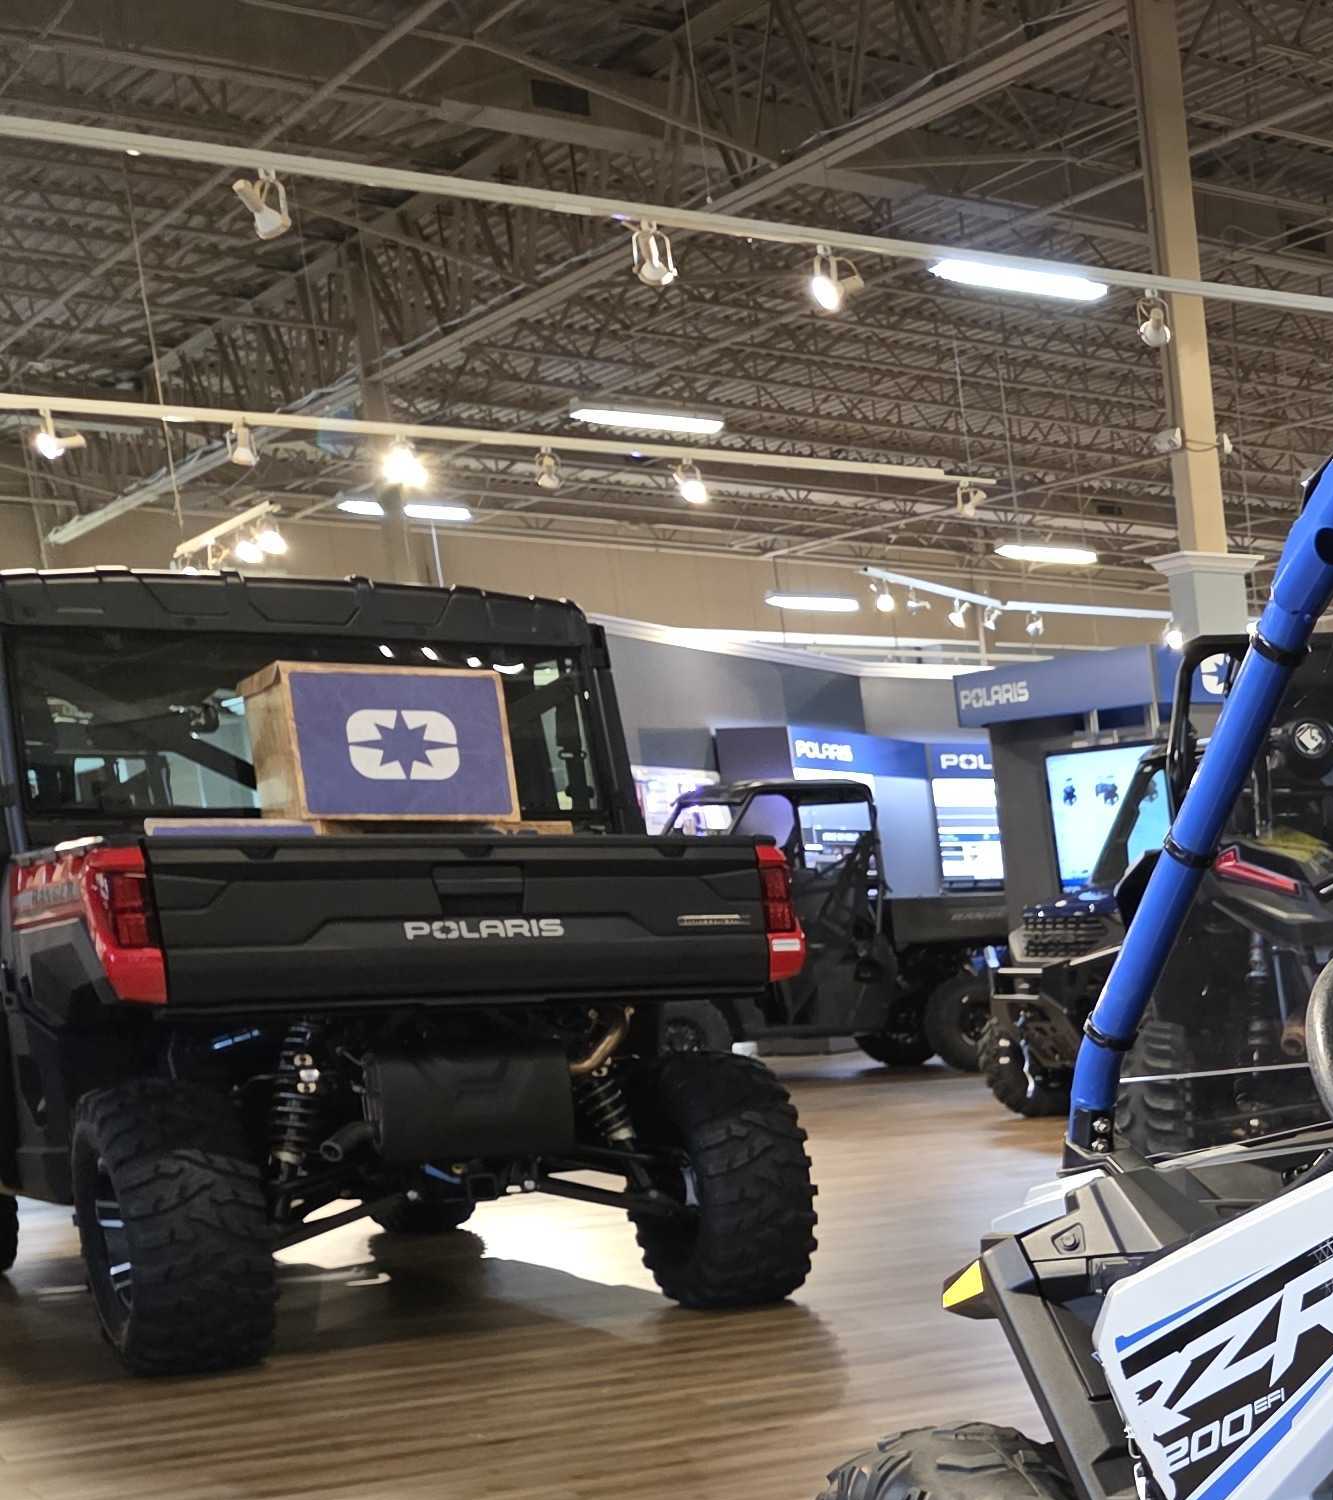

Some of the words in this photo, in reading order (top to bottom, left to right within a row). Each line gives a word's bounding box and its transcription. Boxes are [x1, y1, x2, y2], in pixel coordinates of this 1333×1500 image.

[959, 681, 1030, 710] POLARIS
[794, 739, 855, 763] POLARIS
[403, 918, 565, 940] POLARIS
[1164, 1406, 1255, 1472] 200
[1253, 1387, 1286, 1414] EFI
